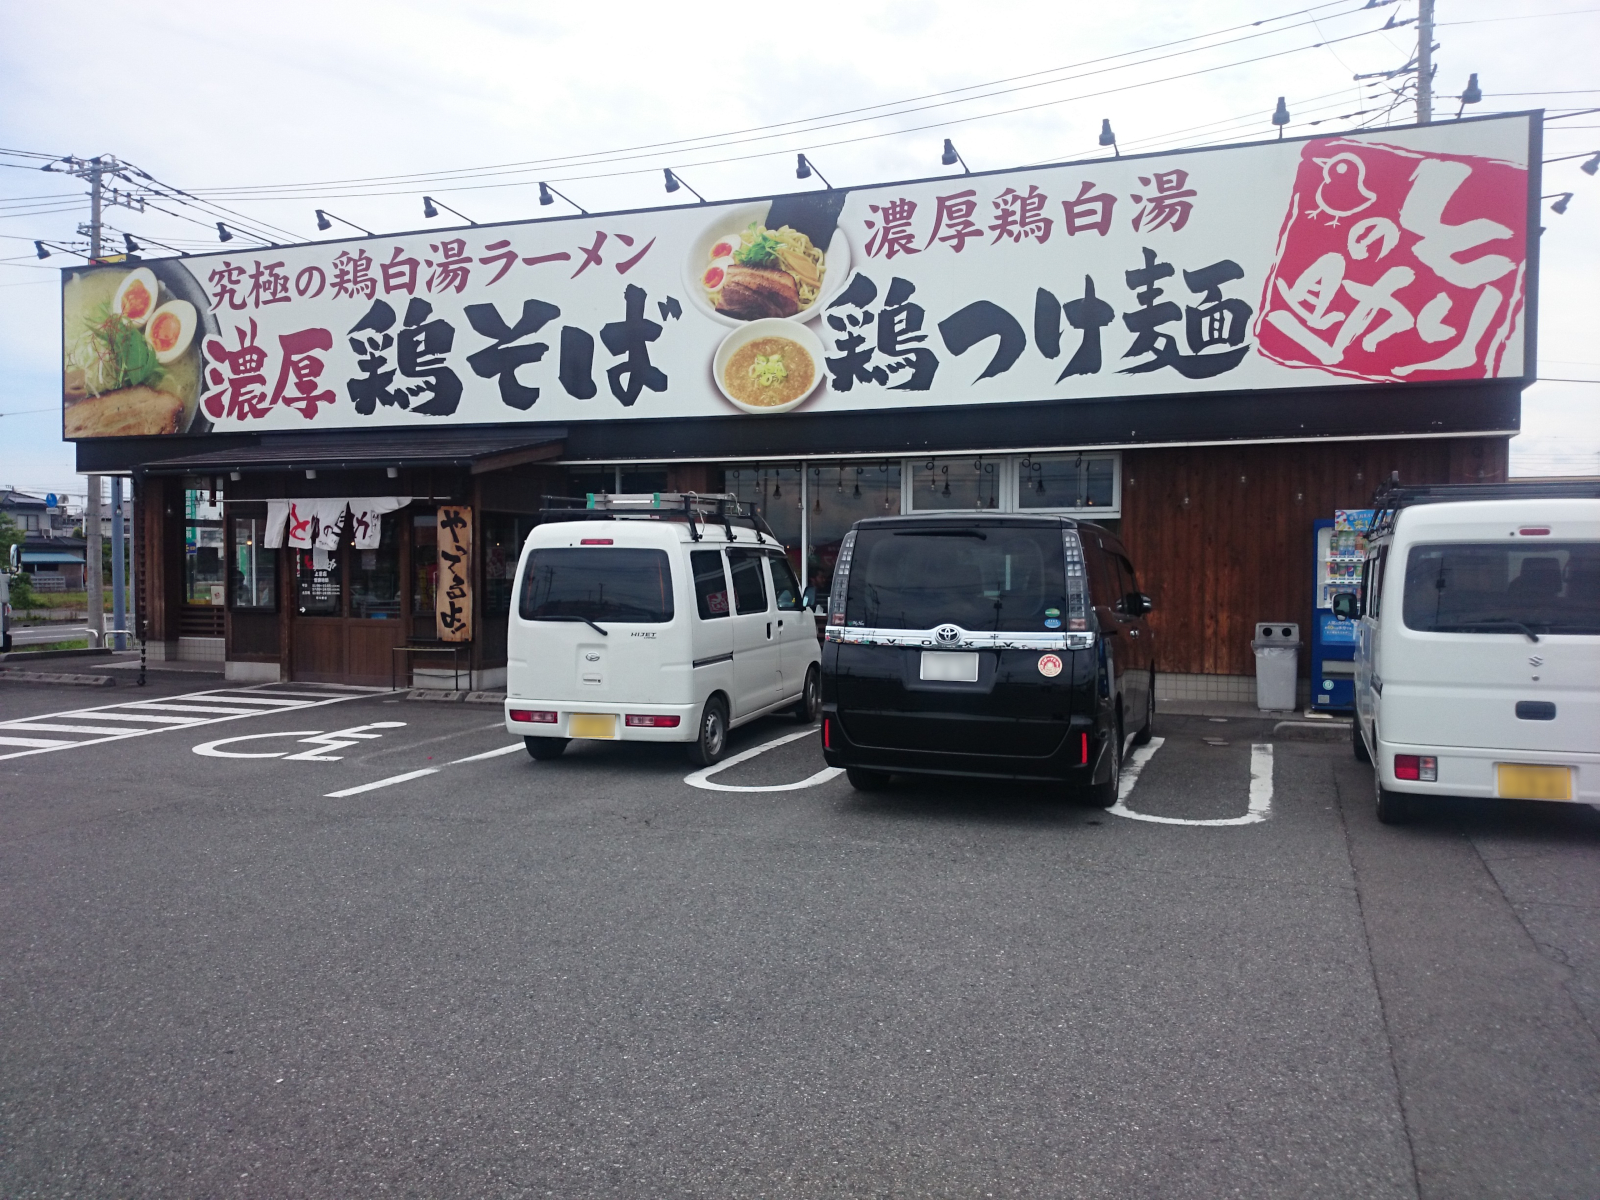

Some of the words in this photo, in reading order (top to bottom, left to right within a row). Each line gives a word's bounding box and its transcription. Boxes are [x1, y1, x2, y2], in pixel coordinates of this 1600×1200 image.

[864, 168, 1198, 260] 濃厚鶏白湯
[207, 231, 657, 312] 究極の鶏白湯ラーメン
[203, 283, 683, 421] 濃厚鶏そば
[825, 246, 1253, 393] 鶏つけ麺
[886, 638, 1015, 648] VOXY
